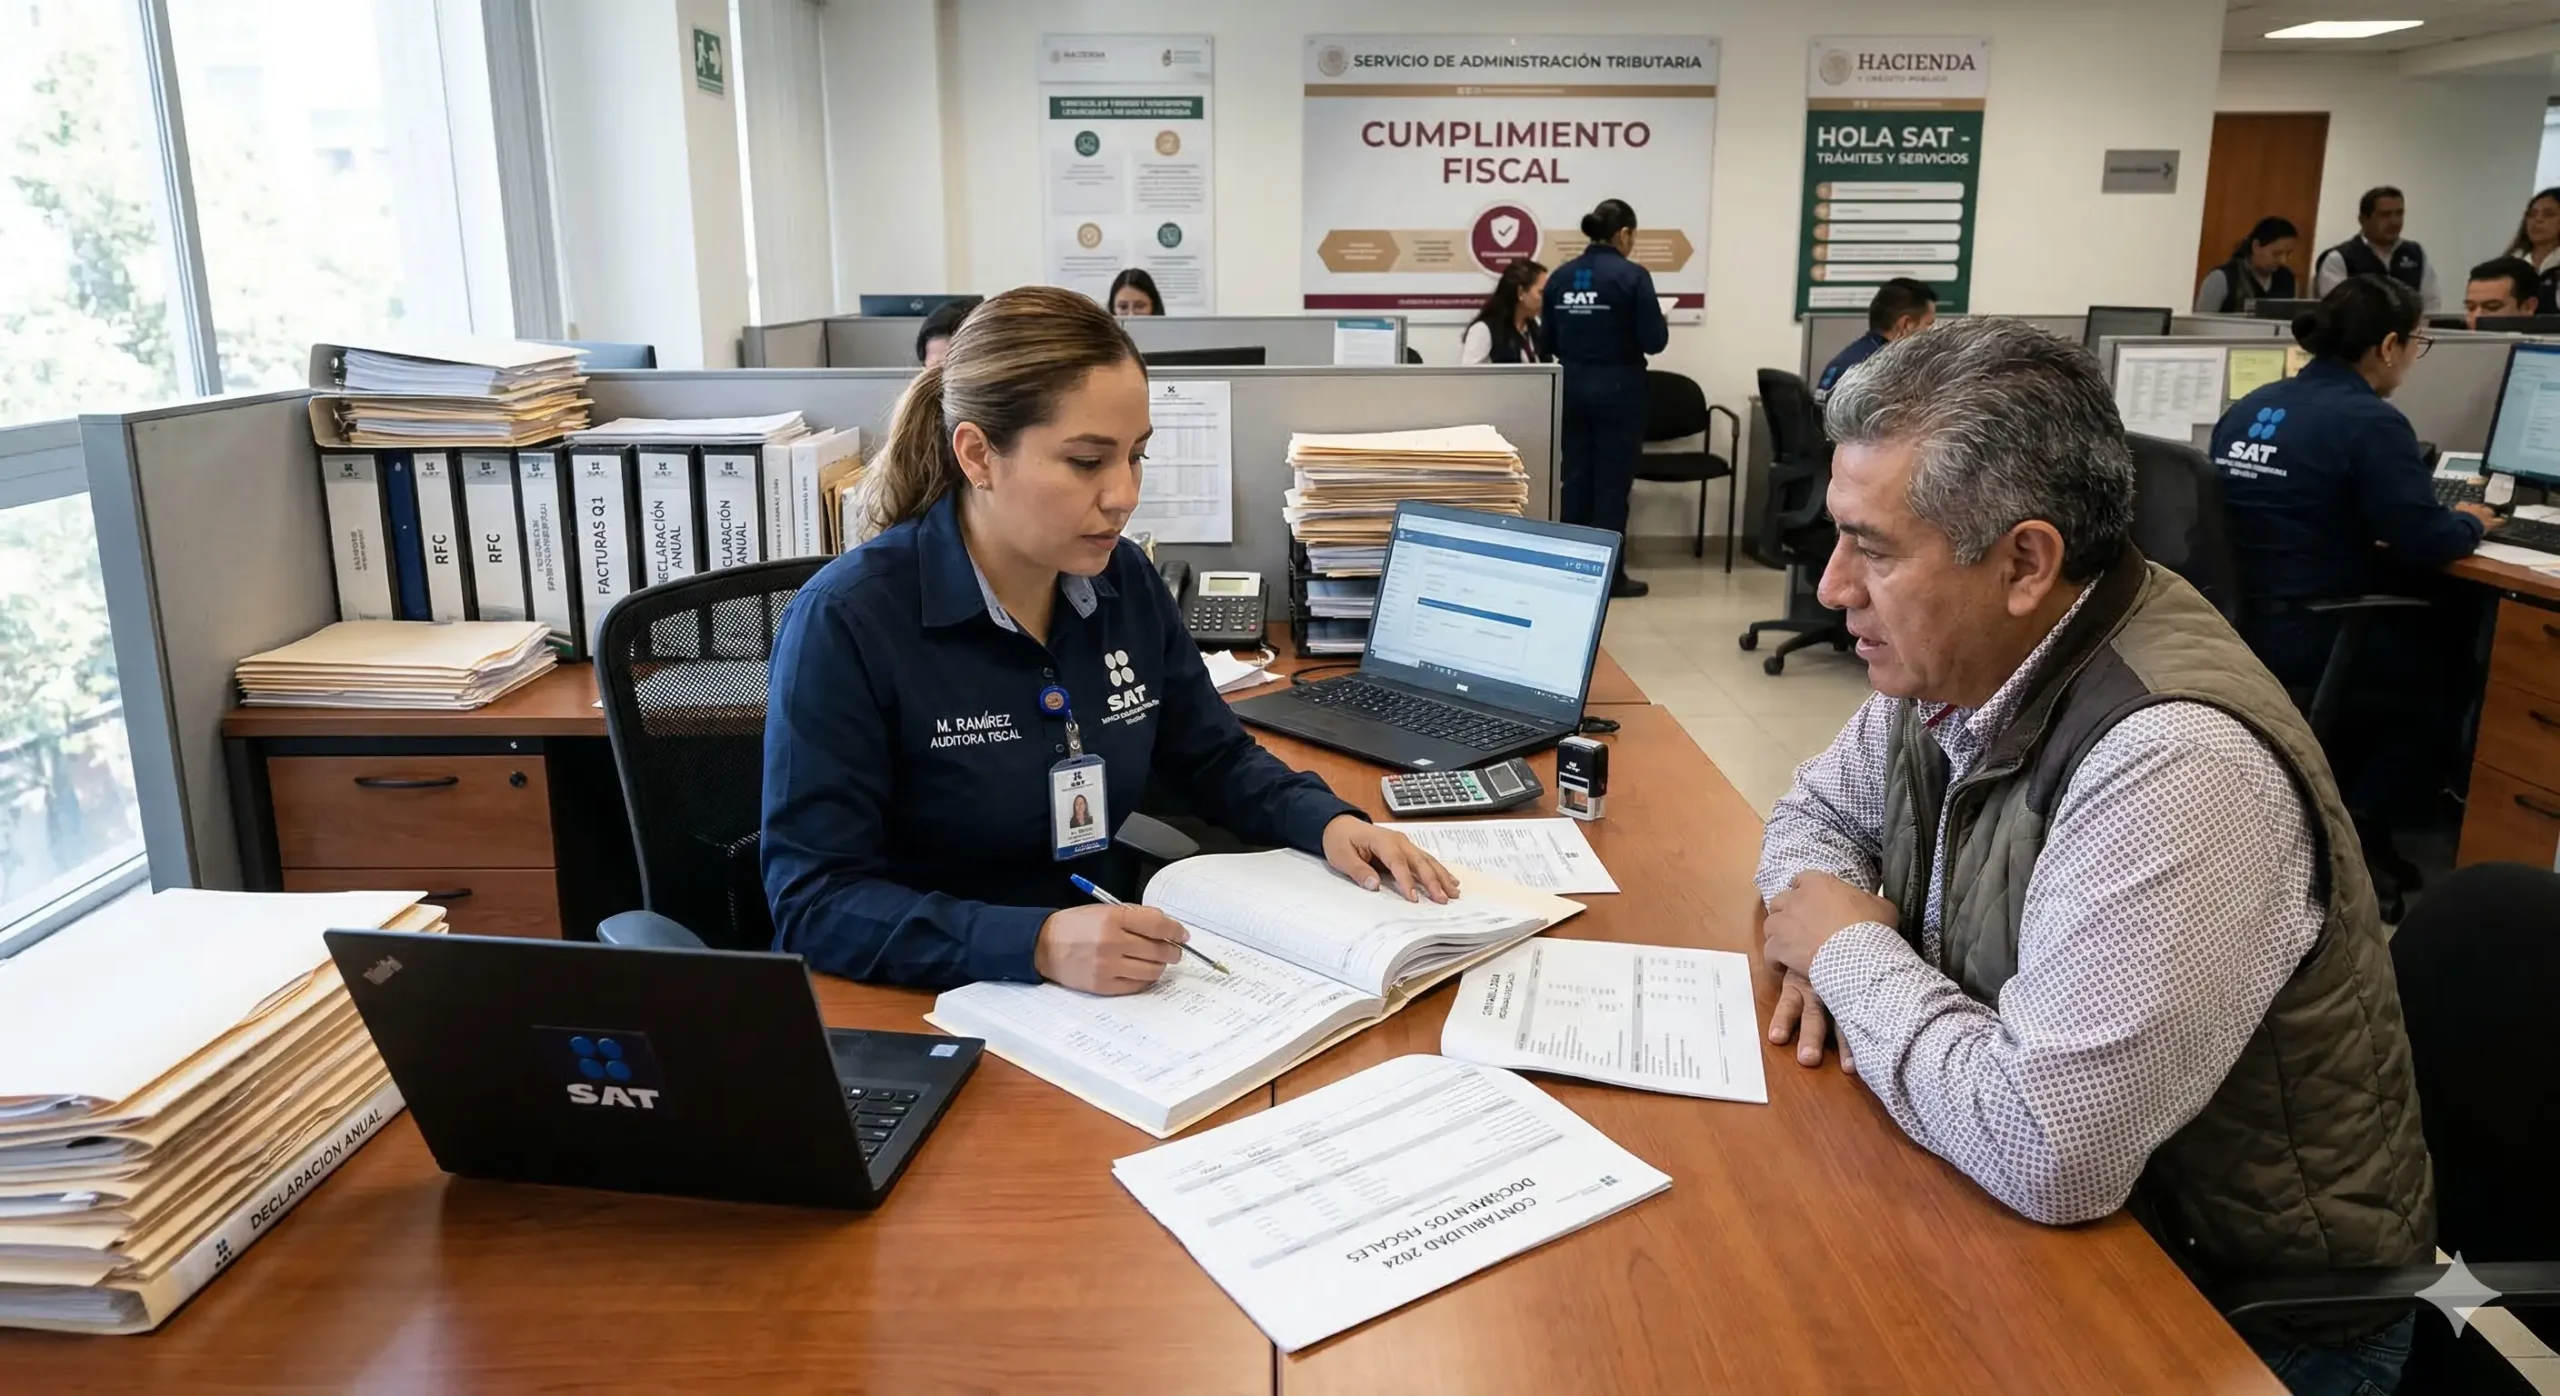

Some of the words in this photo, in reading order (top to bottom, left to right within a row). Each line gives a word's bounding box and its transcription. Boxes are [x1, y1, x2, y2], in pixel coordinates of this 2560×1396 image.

[1353, 54, 1429, 68] SERVICIO
[1434, 55, 1456, 68] DE
[1460, 53, 1601, 69] ADMINISTRACIÓN
[1606, 55, 1702, 69] TRIBUTARIA
[1857, 53, 1976, 71] HACIENDA
[1361, 121, 1651, 148] CUMPLIMIENTO
[1817, 126, 1895, 148] HOLA
[1902, 126, 1954, 148] SAT
[1816, 150, 1884, 165] TRÁMITES
[1887, 153, 1896, 164] Y
[1898, 153, 1970, 165] SERVICIOS
[1443, 158, 1570, 184] FISCAL
[1562, 291, 1598, 305] SAT
[2228, 440, 2278, 464] SAT
[591, 496, 606, 517] Q1
[671, 525, 683, 569] ANUAL
[716, 500, 733, 568] CLARACIÓN
[735, 521, 748, 565] ANUAL
[432, 534, 449, 565] RFC
[486, 533, 503, 563] RFC
[593, 520, 611, 595] FACTURAS
[1107, 684, 1146, 712] SAT
[936, 719, 952, 733] M.
[956, 710, 1012, 731] RAMÍREZ
[930, 733, 986, 749] AUDITORA
[566, 1083, 659, 1109] SAT
[250, 1145, 342, 1231] DECLARACIÓN
[344, 1108, 383, 1150] ANUAL
[1346, 1225, 1422, 1264] FISCALES
[1382, 1247, 1422, 1269] 2024
